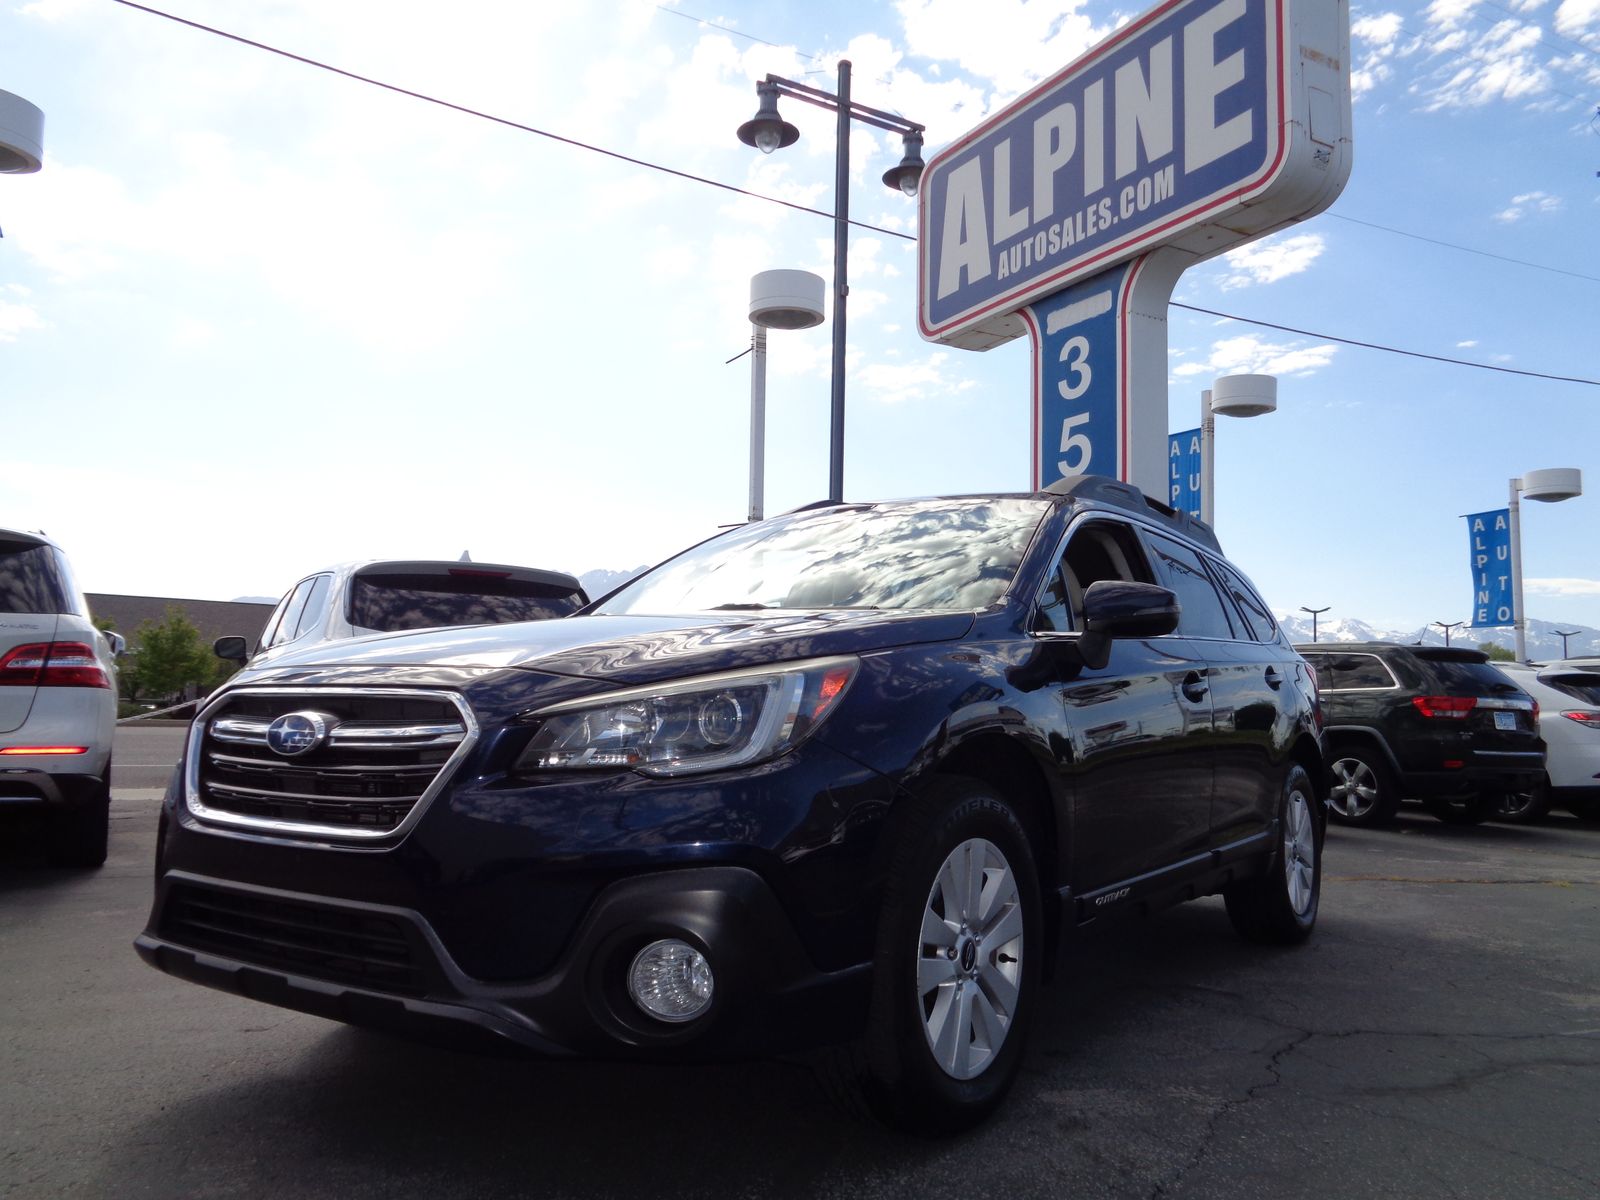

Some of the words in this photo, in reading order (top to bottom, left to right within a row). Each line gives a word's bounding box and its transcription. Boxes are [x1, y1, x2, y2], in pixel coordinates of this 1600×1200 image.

[938, 0, 1253, 300] ALPINE
[998, 166, 1175, 281] AUTOSALES.COM
[1473, 518, 1489, 622] ALPINE
[1495, 515, 1510, 621] AUTO
